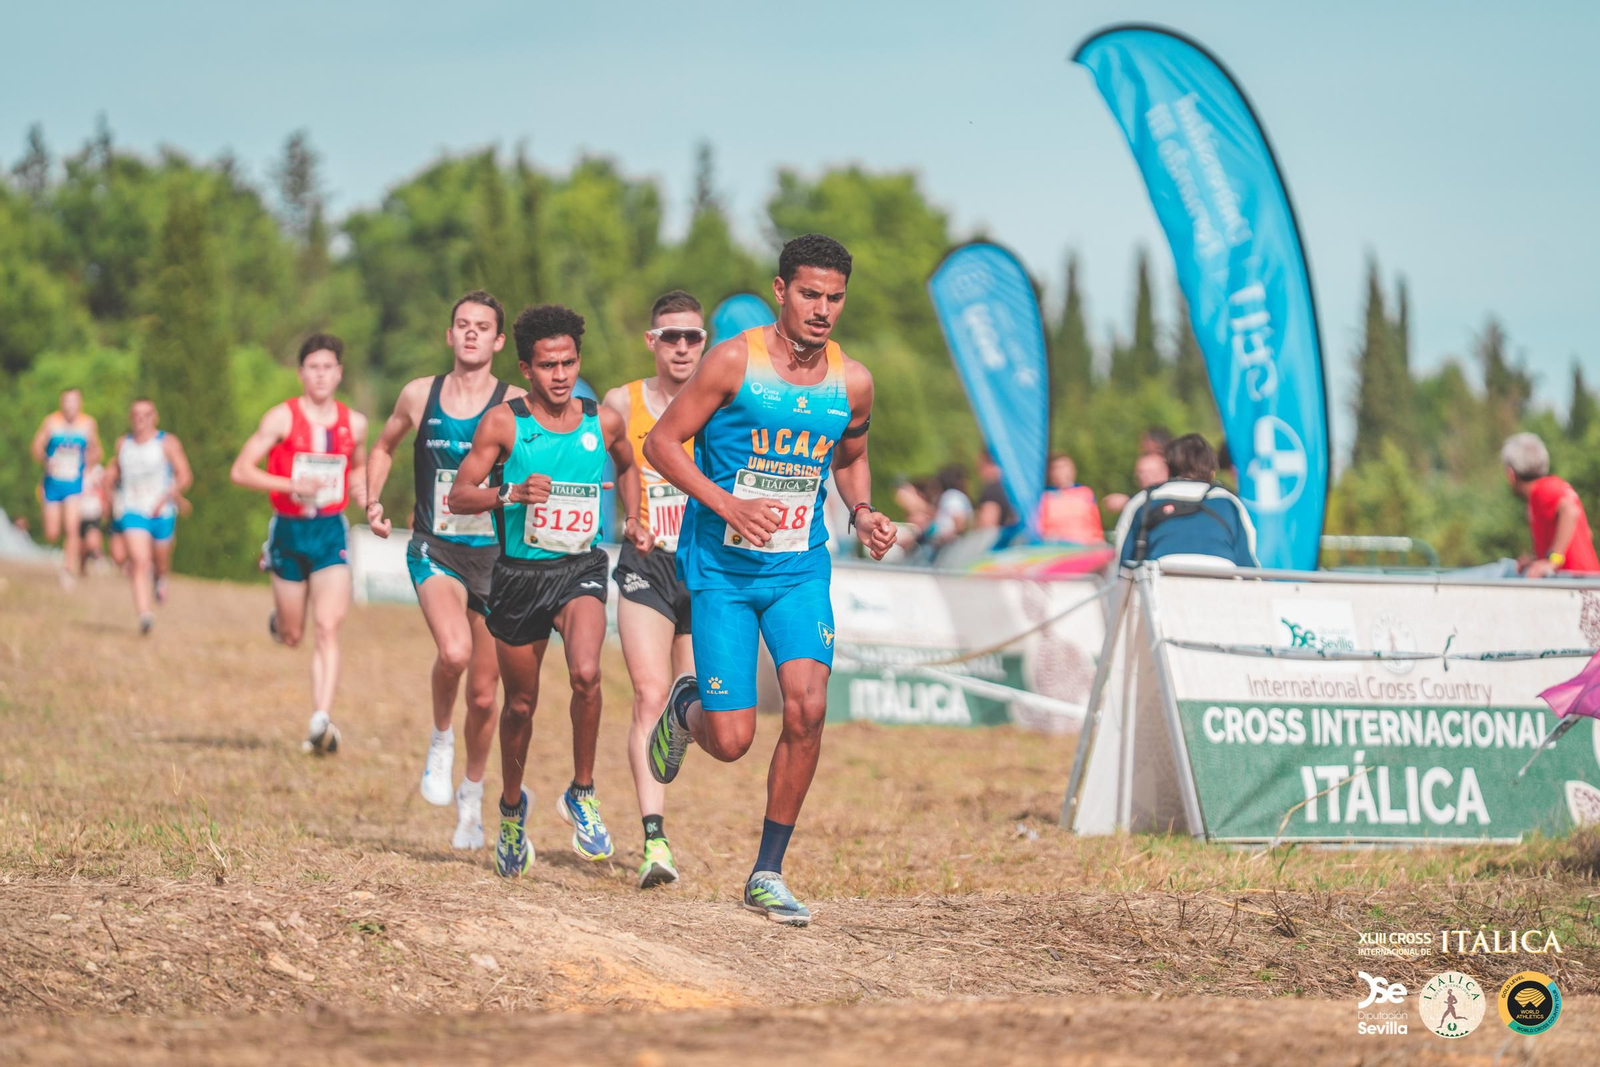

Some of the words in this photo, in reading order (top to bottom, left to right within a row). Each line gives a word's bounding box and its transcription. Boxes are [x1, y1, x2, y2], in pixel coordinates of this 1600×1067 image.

[751, 428, 835, 464] UCAM
[761, 477, 800, 490] ITÁLICA
[532, 507, 594, 533] 5129
[1247, 674, 1364, 700] International
[1366, 676, 1416, 700] Cross
[1421, 677, 1493, 708] Country
[1203, 706, 1306, 745] CROSS
[1311, 708, 1557, 750] INTERNACIONAL
[1301, 750, 1491, 825] ITÁLICA
